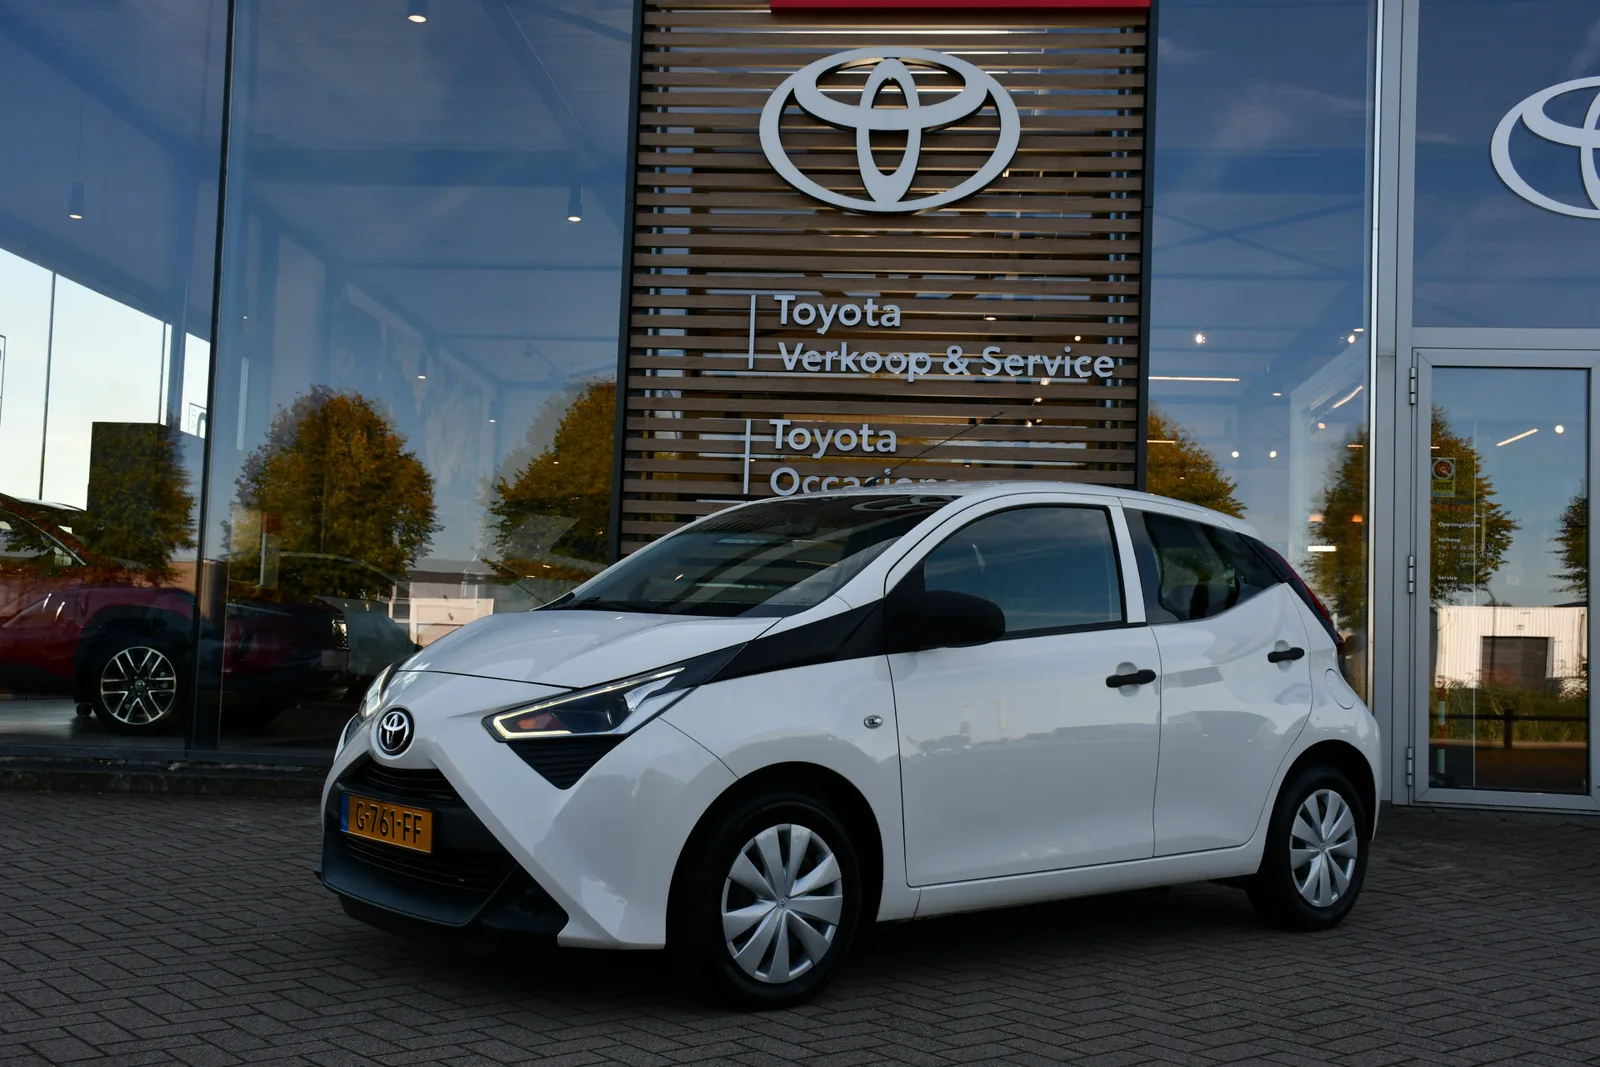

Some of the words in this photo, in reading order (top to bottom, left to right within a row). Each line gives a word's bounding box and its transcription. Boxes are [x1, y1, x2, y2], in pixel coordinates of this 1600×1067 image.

[774, 294, 902, 335] Toyota
[777, 341, 932, 383] Verkoop
[942, 345, 970, 376] &
[981, 345, 1115, 378] Service
[769, 419, 898, 460] Toyota
[1438, 521, 1481, 529] Openingstijden
[355, 801, 423, 844] G-761-FF
